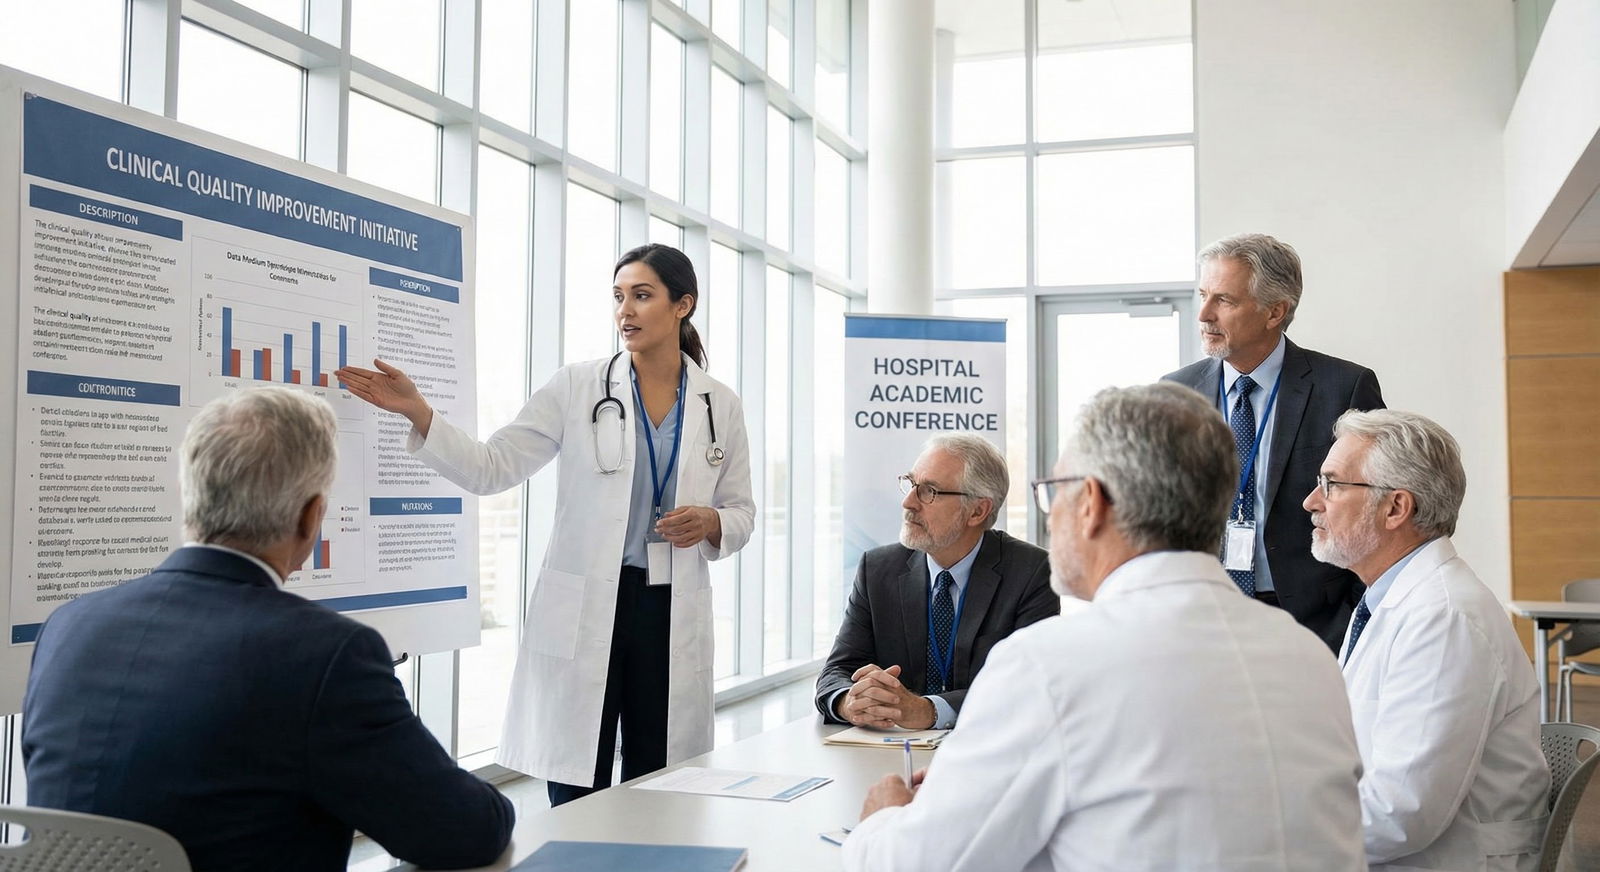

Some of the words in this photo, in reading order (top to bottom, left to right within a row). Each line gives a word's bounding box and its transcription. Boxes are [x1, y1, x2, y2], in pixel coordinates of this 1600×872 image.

[106, 147, 183, 188] CLINICAL
[187, 170, 252, 206] QUALITY
[257, 190, 356, 234] IMPROVEMENT
[360, 218, 419, 251] INITIATIVE
[80, 203, 138, 225] DESCRIPTION
[35, 219, 46, 229] The
[71, 228, 93, 239] quality
[227, 252, 241, 262] Data
[34, 306, 46, 315] The
[874, 358, 980, 378] HOSPITAL
[870, 384, 983, 404] ACADEMIC
[855, 411, 998, 431] CONFERENCE
